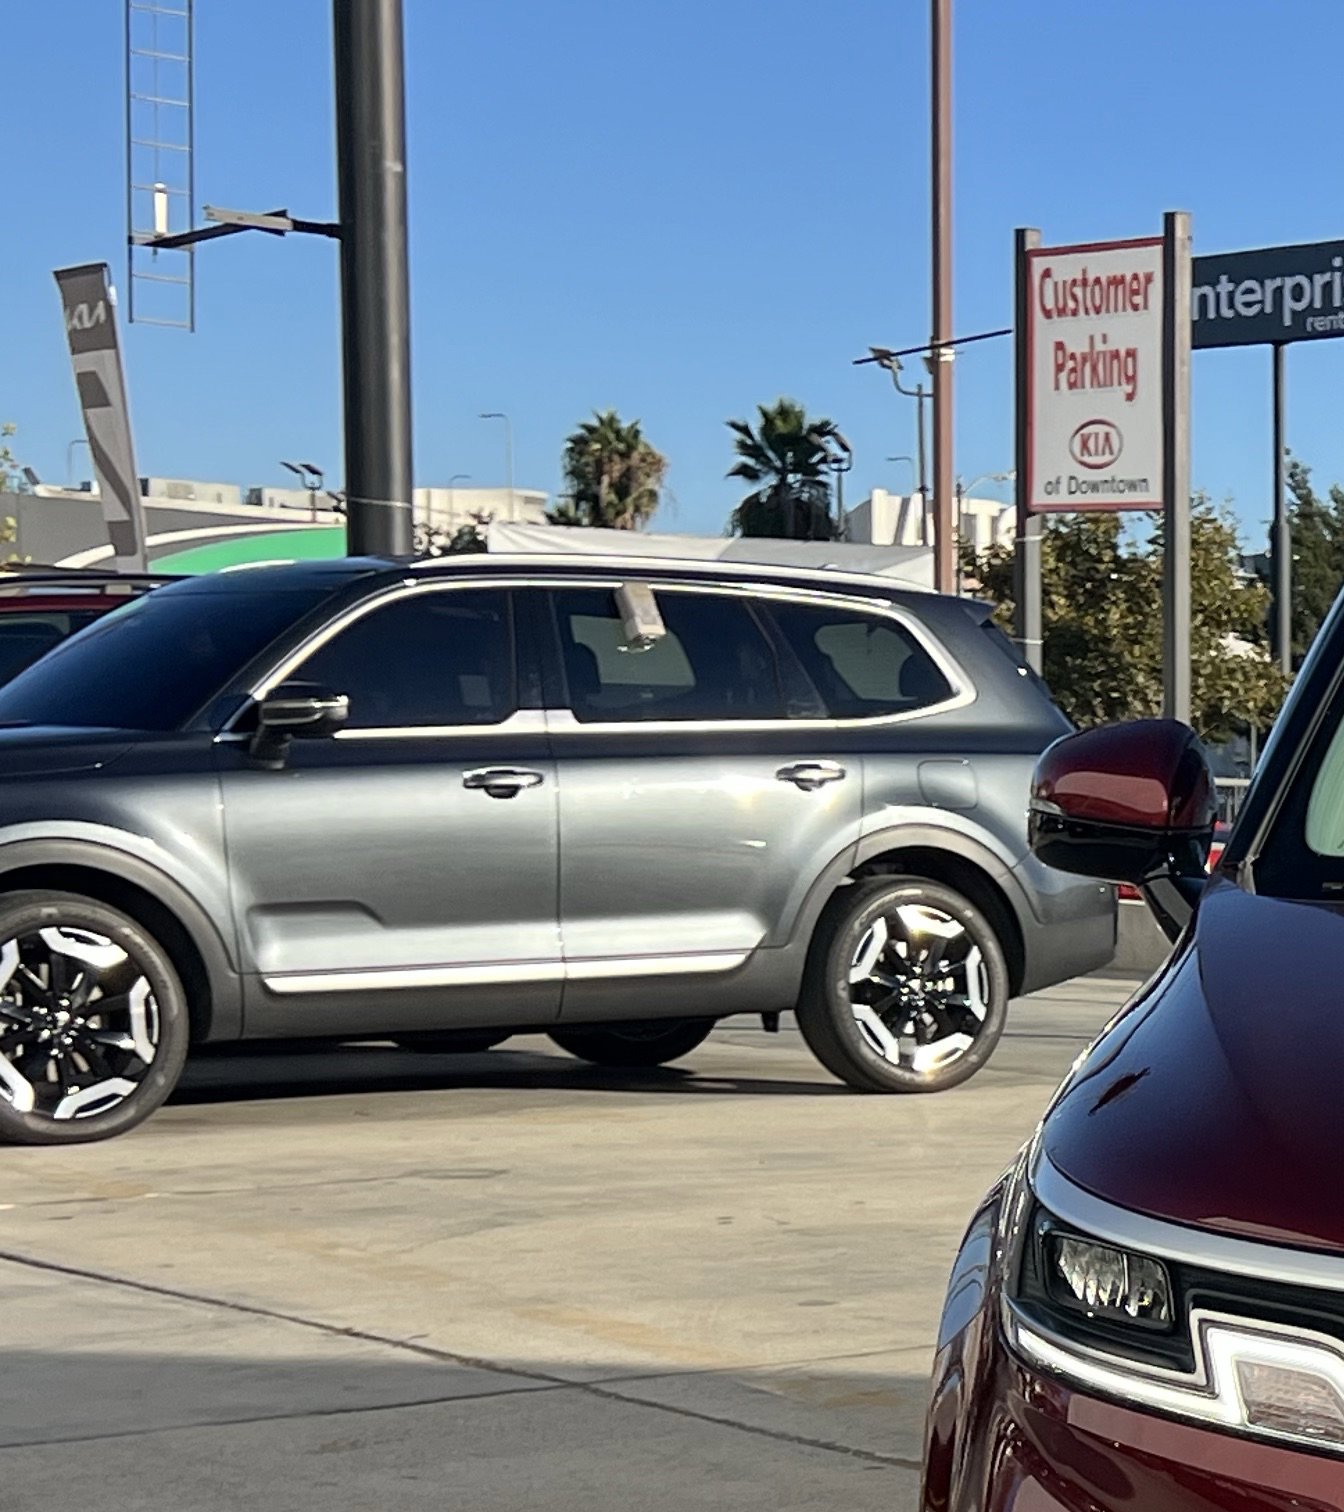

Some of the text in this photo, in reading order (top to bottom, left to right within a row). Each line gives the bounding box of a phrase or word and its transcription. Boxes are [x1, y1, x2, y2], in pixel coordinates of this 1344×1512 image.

[1039, 267, 1155, 320] Customer
[1053, 334, 1139, 402] Parking
[1079, 432, 1114, 457] KIA
[1044, 475, 1150, 496] of Downtown
